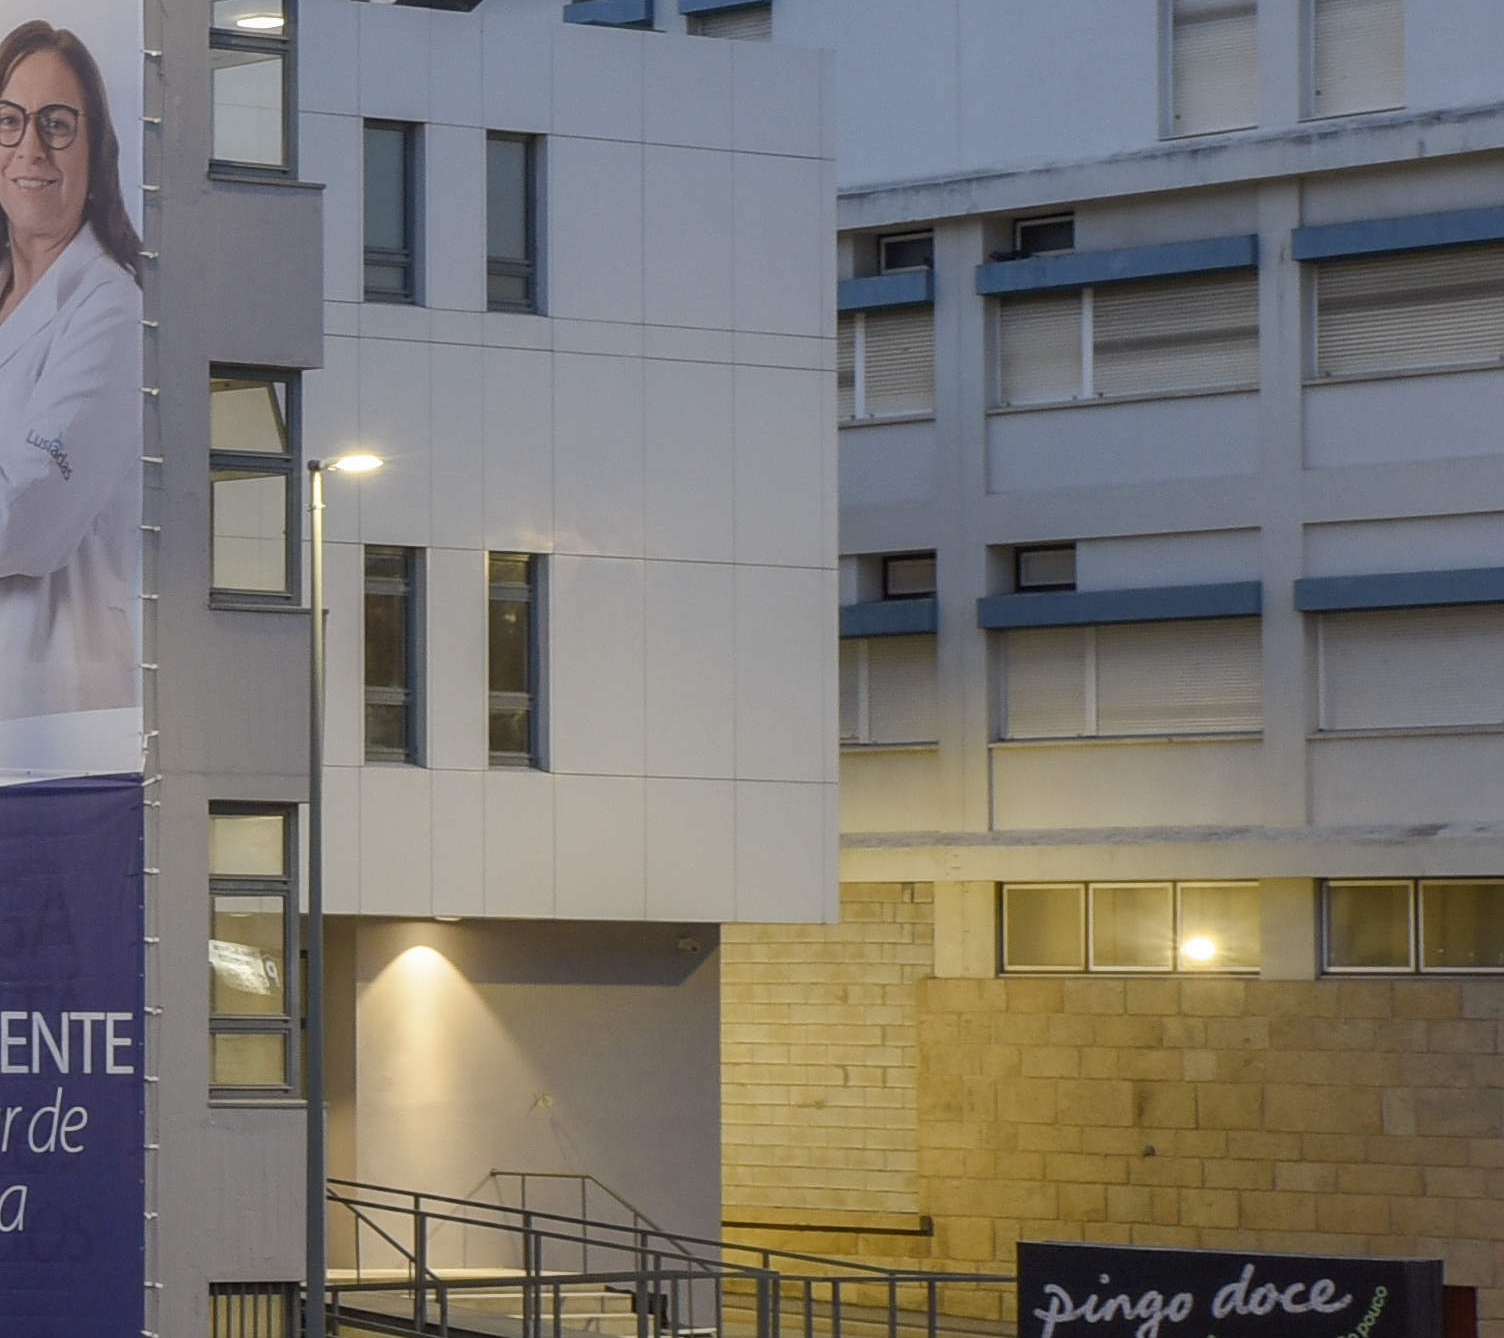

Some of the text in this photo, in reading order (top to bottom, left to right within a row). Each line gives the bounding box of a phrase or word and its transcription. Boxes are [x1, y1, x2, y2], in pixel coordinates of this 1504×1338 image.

[27, 1086, 89, 1154] de
[1210, 1262, 1354, 1320] doce
[1355, 1285, 1389, 1338] pouco
